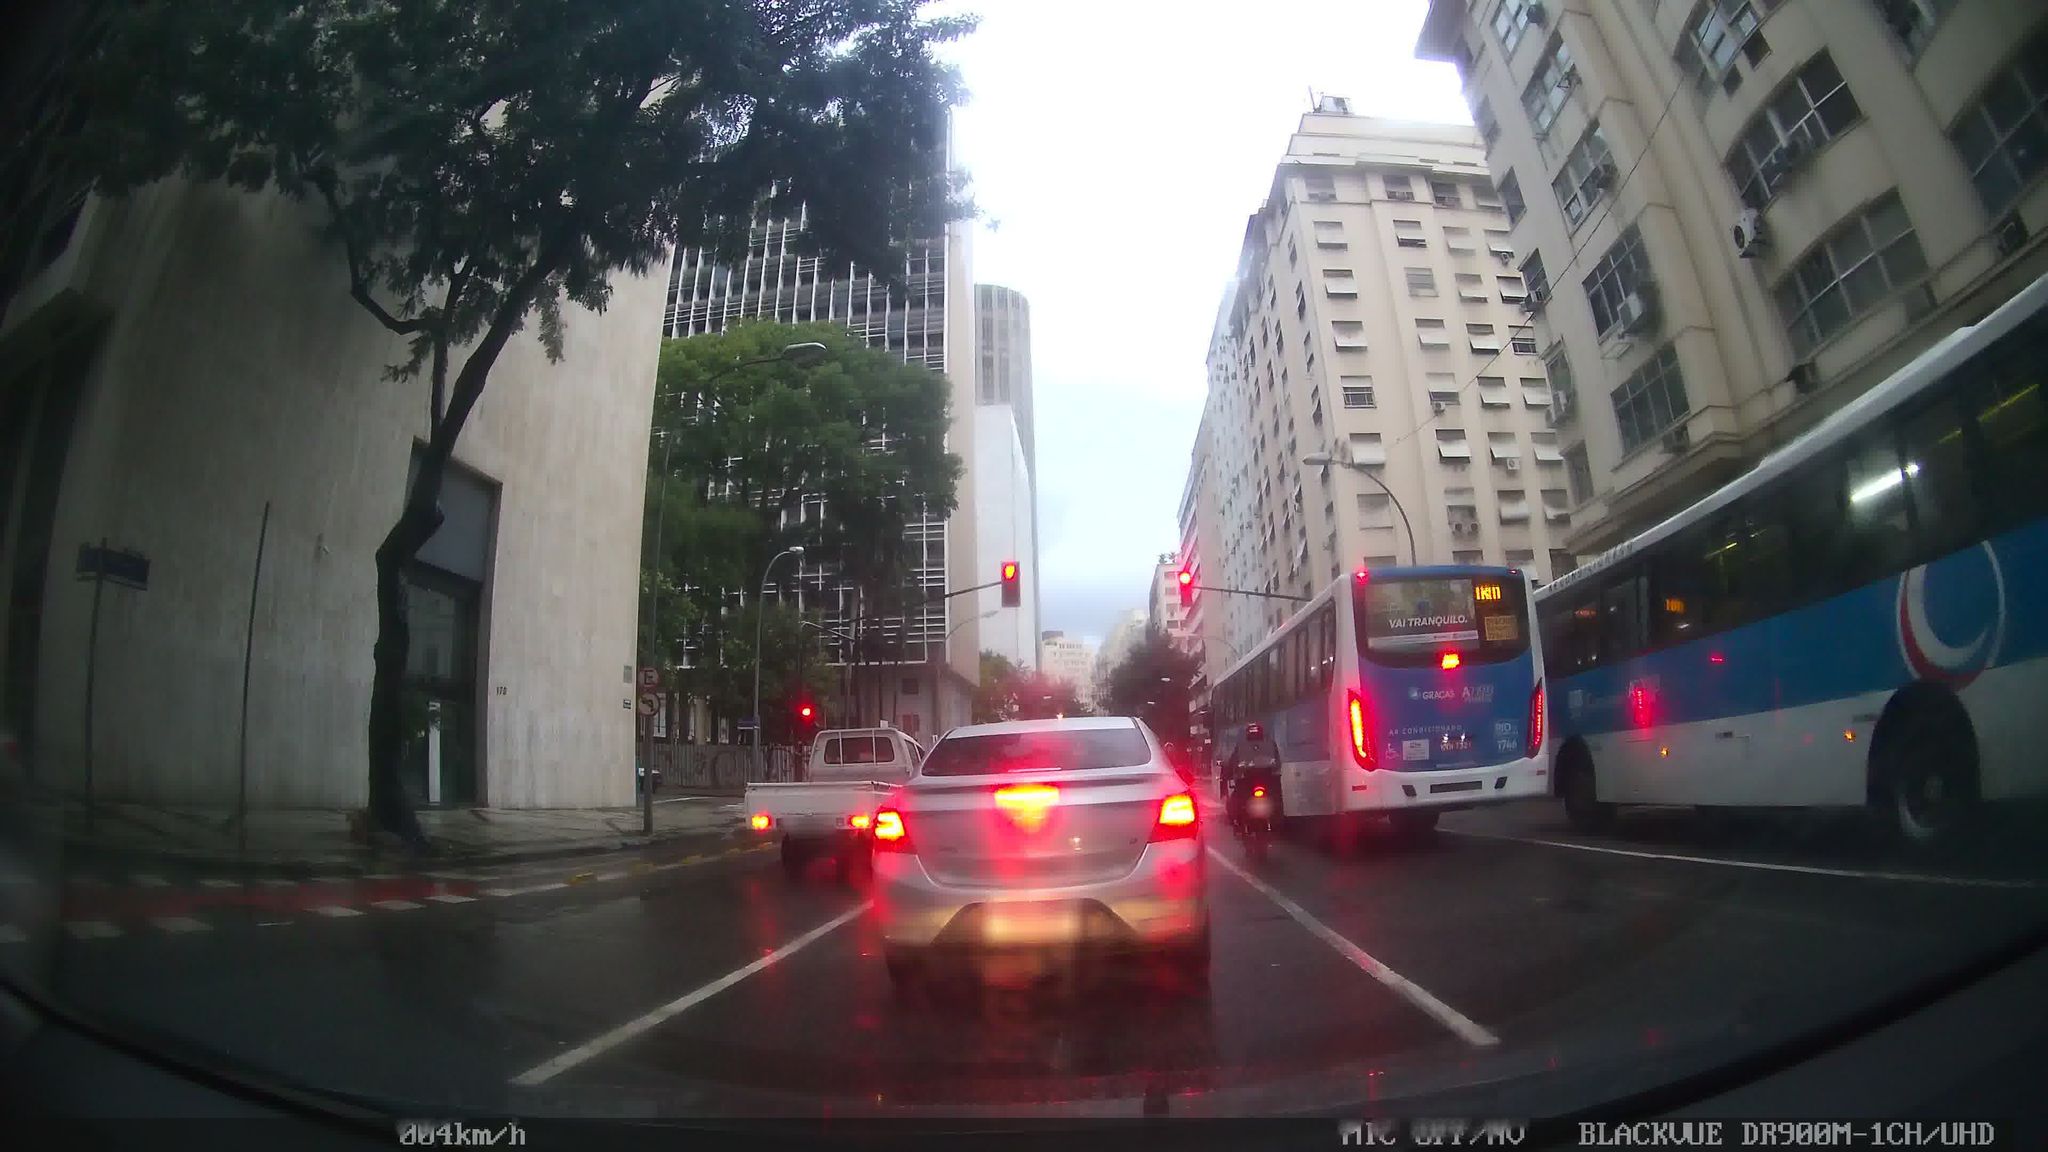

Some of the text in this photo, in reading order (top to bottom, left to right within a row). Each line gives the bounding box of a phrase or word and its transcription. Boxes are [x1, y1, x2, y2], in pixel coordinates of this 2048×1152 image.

[1388, 615, 1468, 629] VAI TRANQUILO.
[644, 669, 654, 685] E
